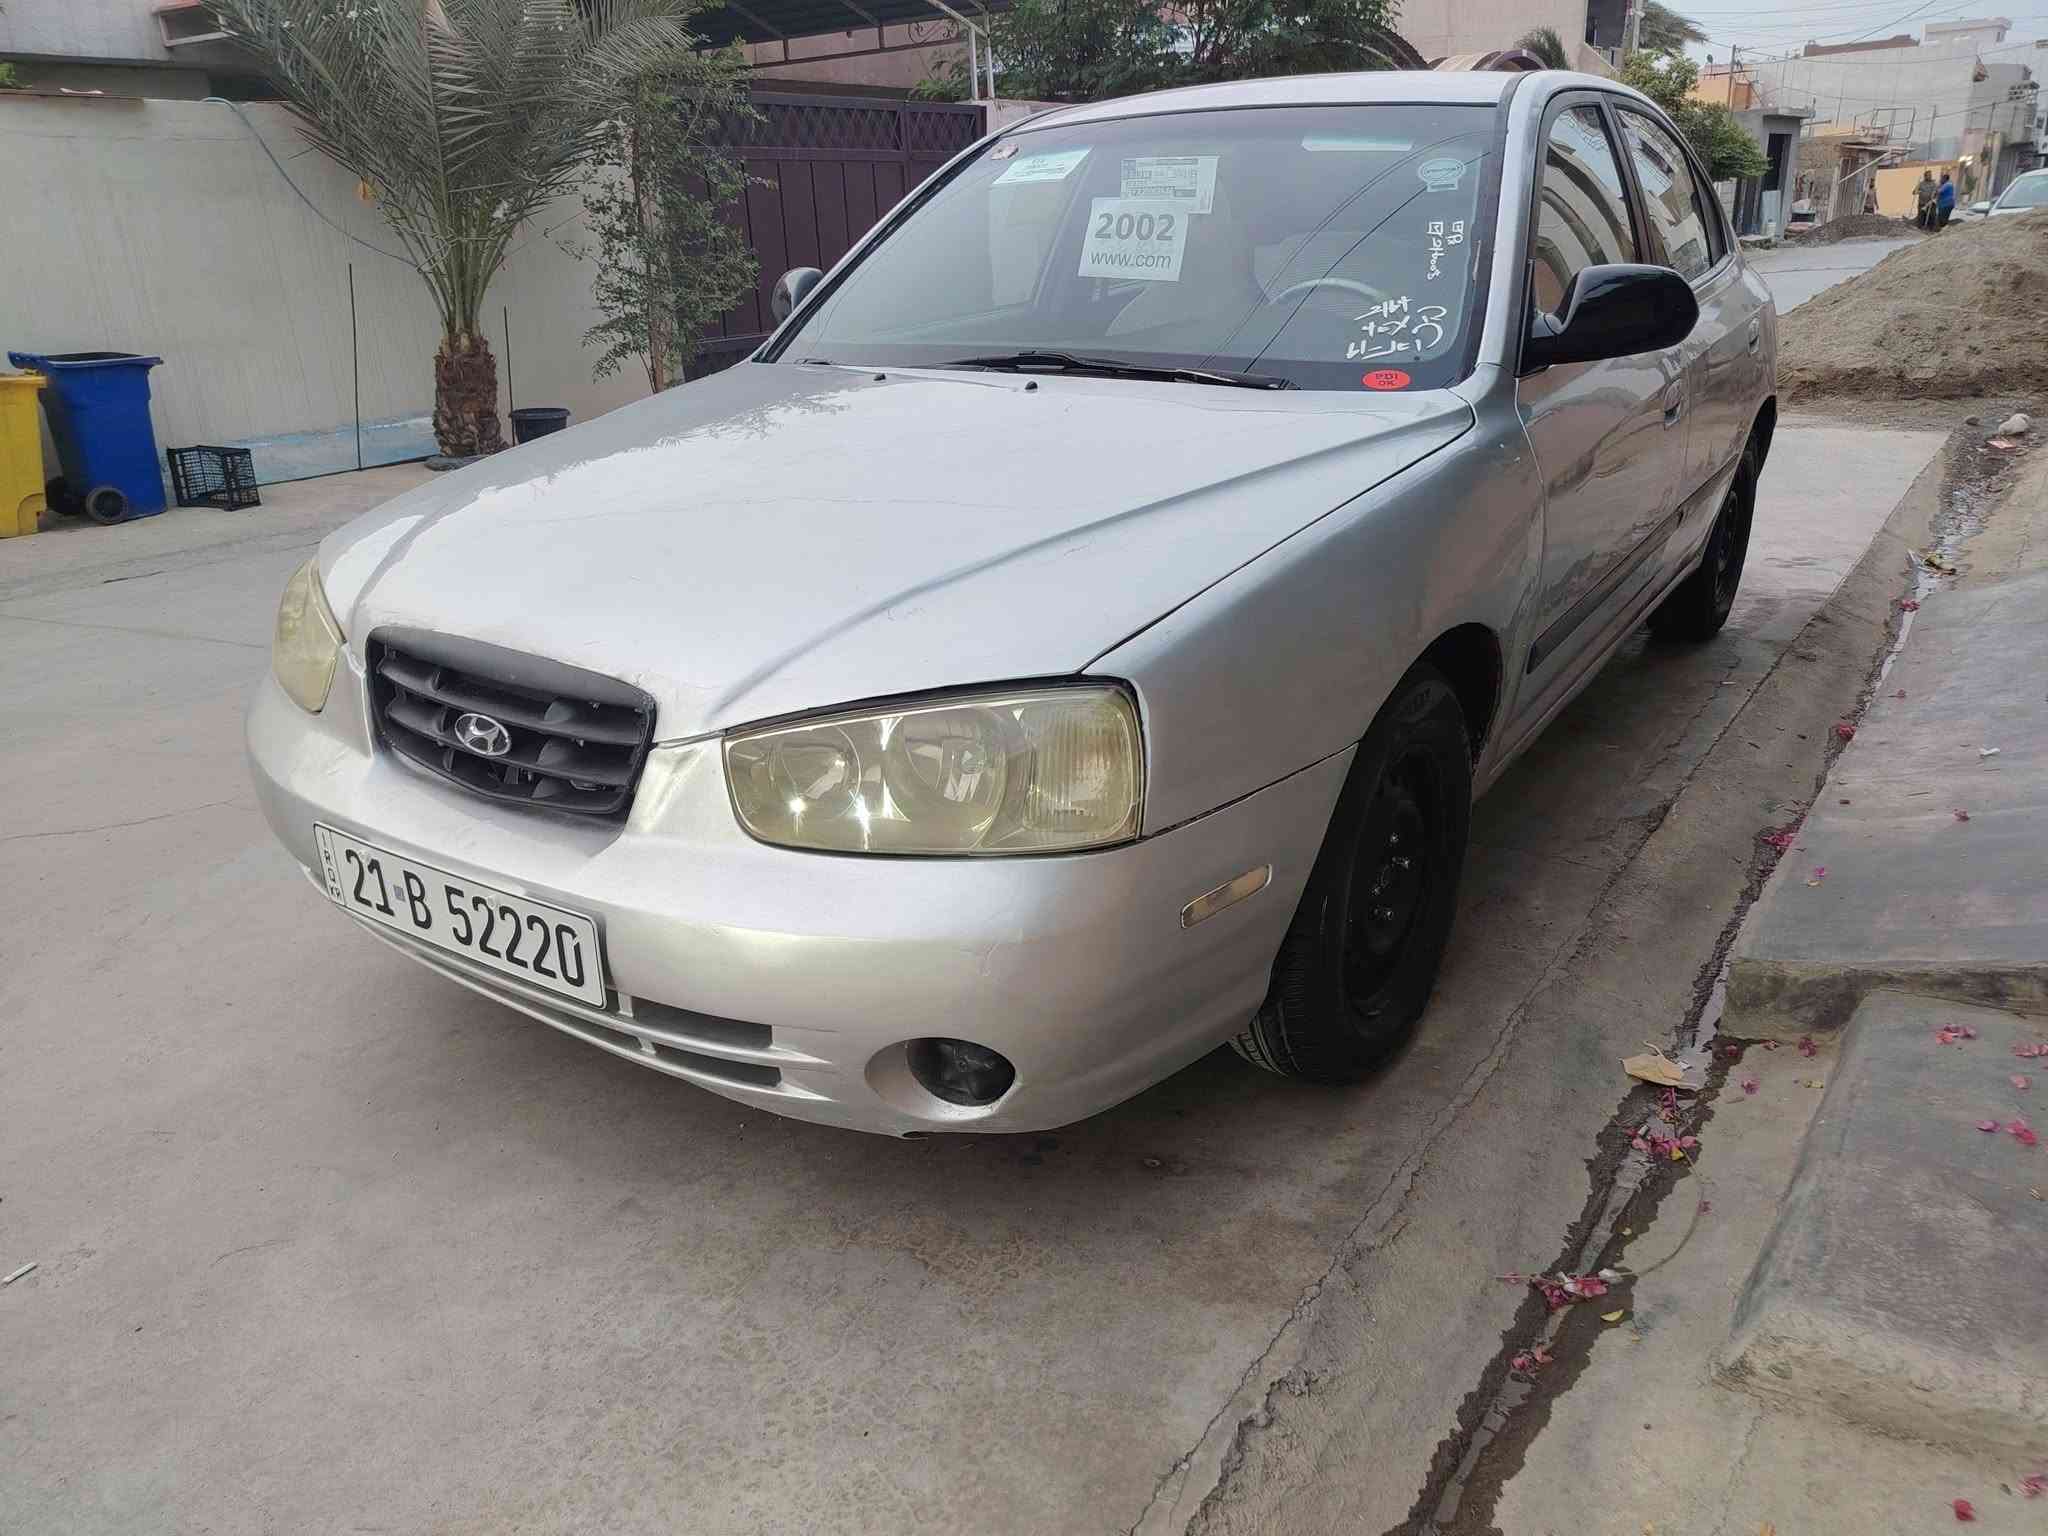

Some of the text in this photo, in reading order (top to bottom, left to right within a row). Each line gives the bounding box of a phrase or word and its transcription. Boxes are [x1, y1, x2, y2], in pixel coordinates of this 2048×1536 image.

[1094, 213, 1175, 241] 2002
[1090, 249, 1172, 269] www.com
[346, 849, 585, 988] 21 B 52220
